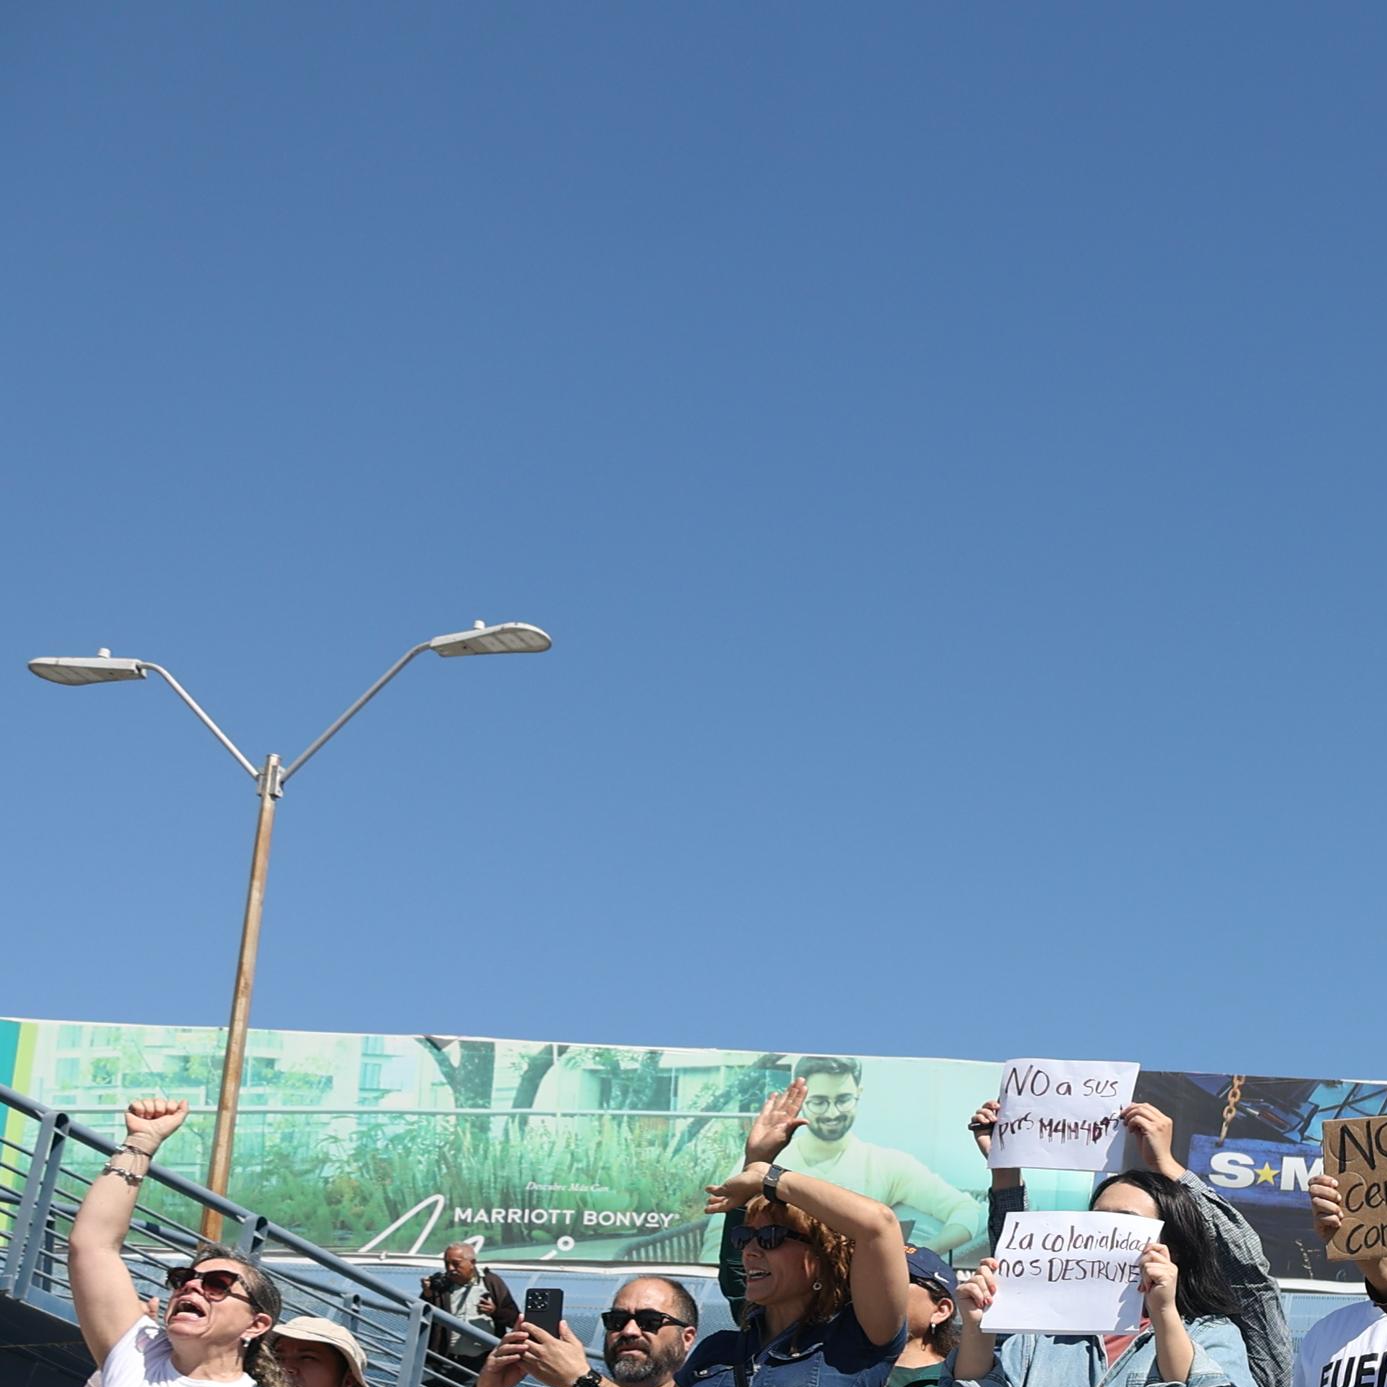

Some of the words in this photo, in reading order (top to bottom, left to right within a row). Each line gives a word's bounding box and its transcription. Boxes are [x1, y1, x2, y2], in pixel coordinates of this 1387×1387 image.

[1005, 1064, 1050, 1097] NO
[1056, 1080, 1073, 1097] a
[454, 1206, 576, 1226] MARRIOTT
[1005, 1221, 1035, 1251] La
[998, 1258, 1042, 1279] nos
[1047, 1256, 1140, 1284] DESTRUYE
